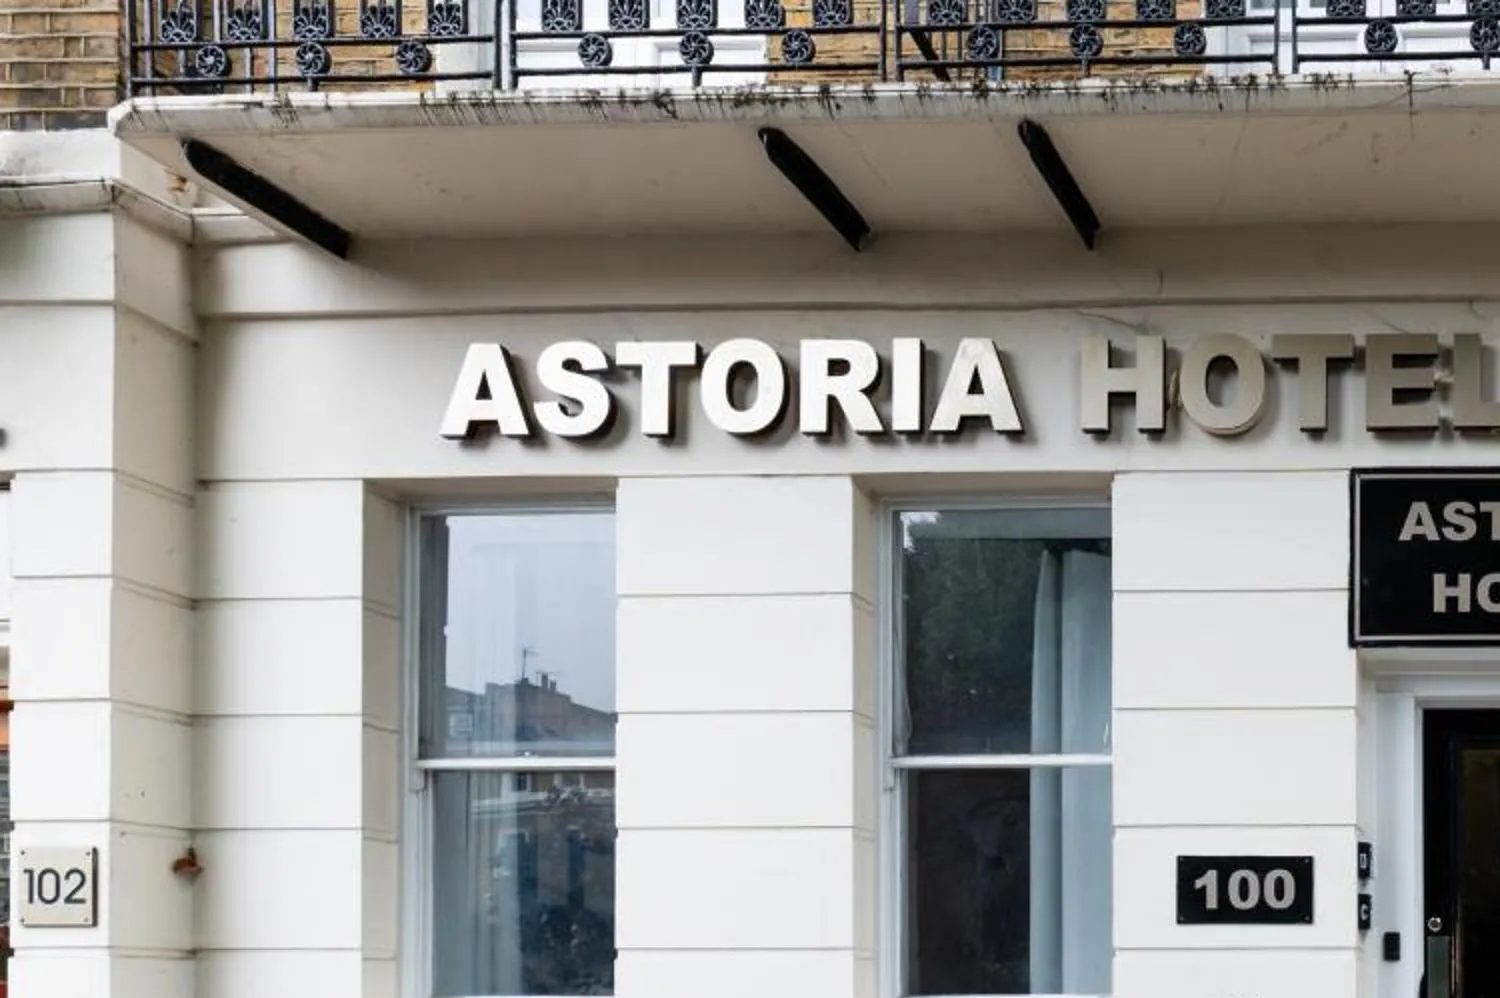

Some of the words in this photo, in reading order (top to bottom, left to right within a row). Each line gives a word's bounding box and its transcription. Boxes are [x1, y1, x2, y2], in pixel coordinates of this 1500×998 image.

[441, 337, 1025, 440] ASTORIA
[23, 867, 87, 905] 102
[1194, 869, 1296, 910] 100
